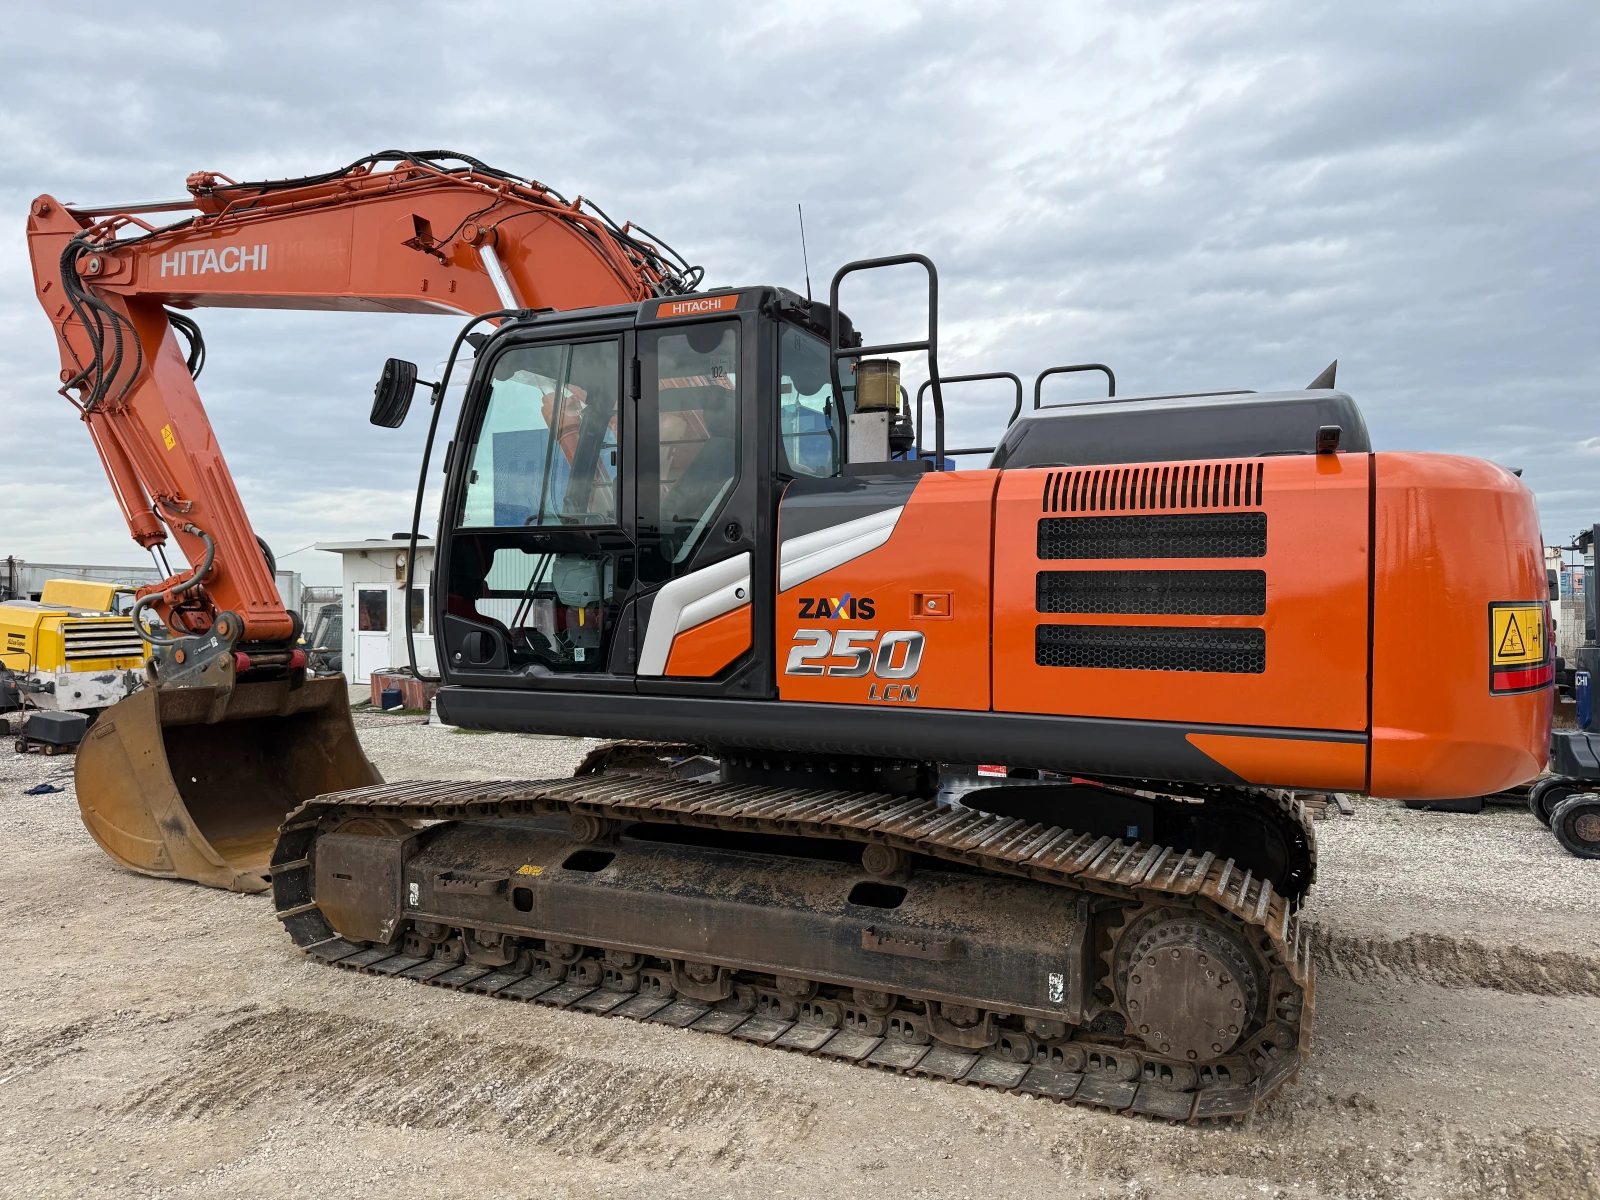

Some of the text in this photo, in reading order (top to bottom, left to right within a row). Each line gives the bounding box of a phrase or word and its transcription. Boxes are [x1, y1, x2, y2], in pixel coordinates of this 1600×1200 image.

[161, 245, 268, 278] HITACHI
[672, 299, 722, 314] HITACHI
[711, 366, 723, 378] 102
[798, 592, 876, 620] ZAXIS
[784, 628, 926, 679] 250
[867, 683, 920, 702] LCN
